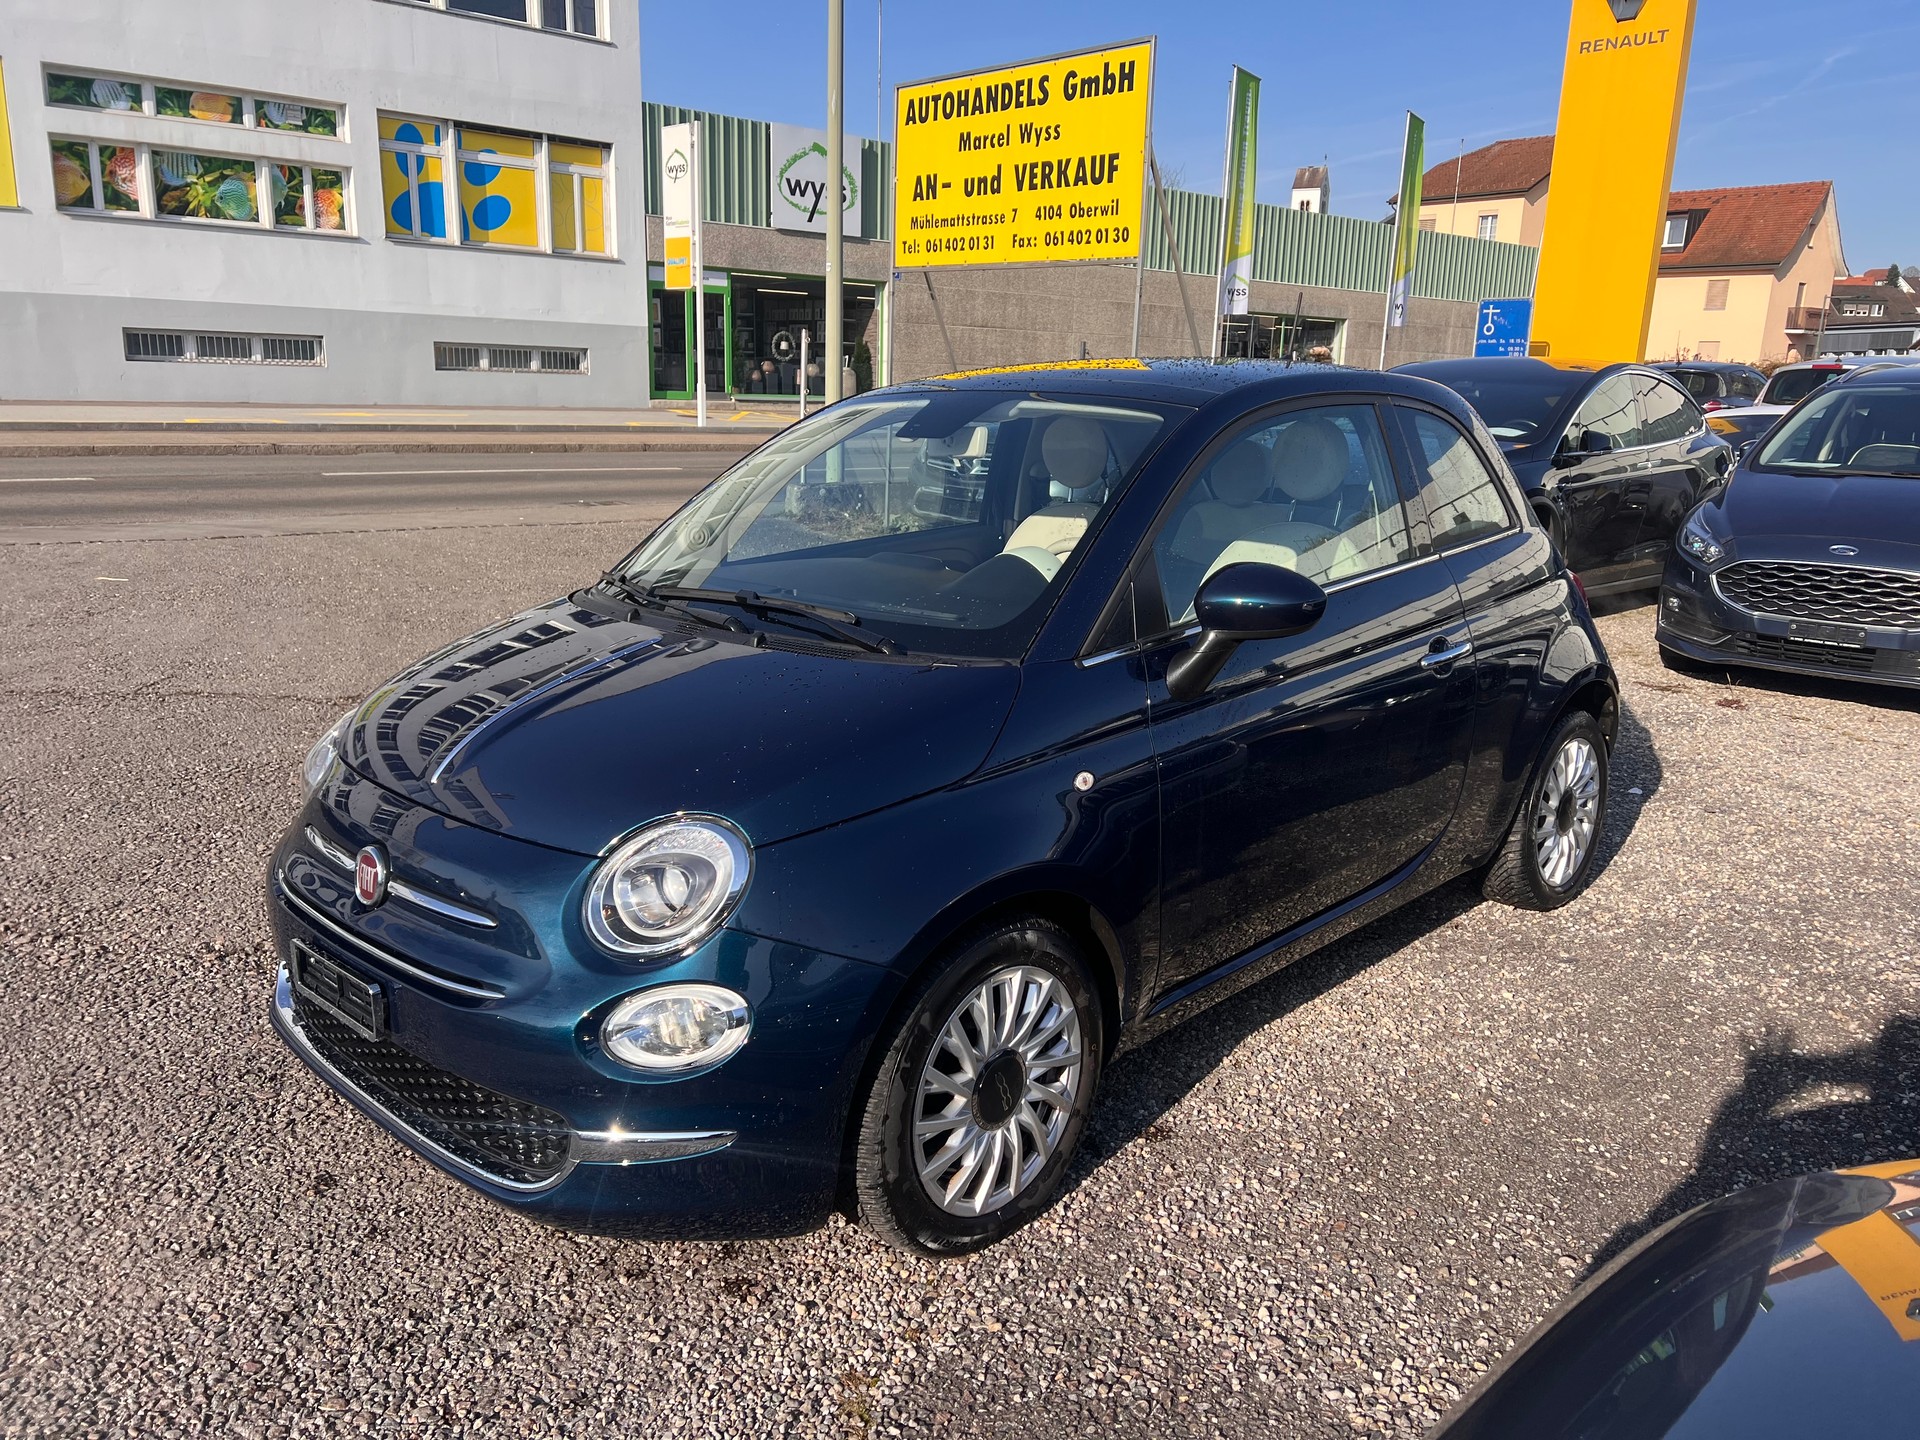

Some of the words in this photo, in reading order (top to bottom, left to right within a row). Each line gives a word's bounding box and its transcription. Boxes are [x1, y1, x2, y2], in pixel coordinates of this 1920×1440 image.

[1579, 28, 1670, 54] RENAULT
[904, 74, 1050, 126] AUTOHANDELS
[1063, 60, 1136, 102] GmbH
[958, 123, 1010, 152] Marcel
[1019, 122, 1062, 147] Wyss
[667, 164, 686, 183] wyss
[964, 164, 1003, 197] und
[1014, 152, 1120, 192] VERKAUF
[910, 211, 1006, 230] Mühlemattstrasse
[1011, 208, 1018, 223] 7
[1035, 204, 1063, 221] 4104
[1069, 198, 1120, 218] Oberwil
[902, 239, 920, 254] Tel:
[1012, 233, 1037, 248] Fax:
[359, 862, 377, 893] FIAT
